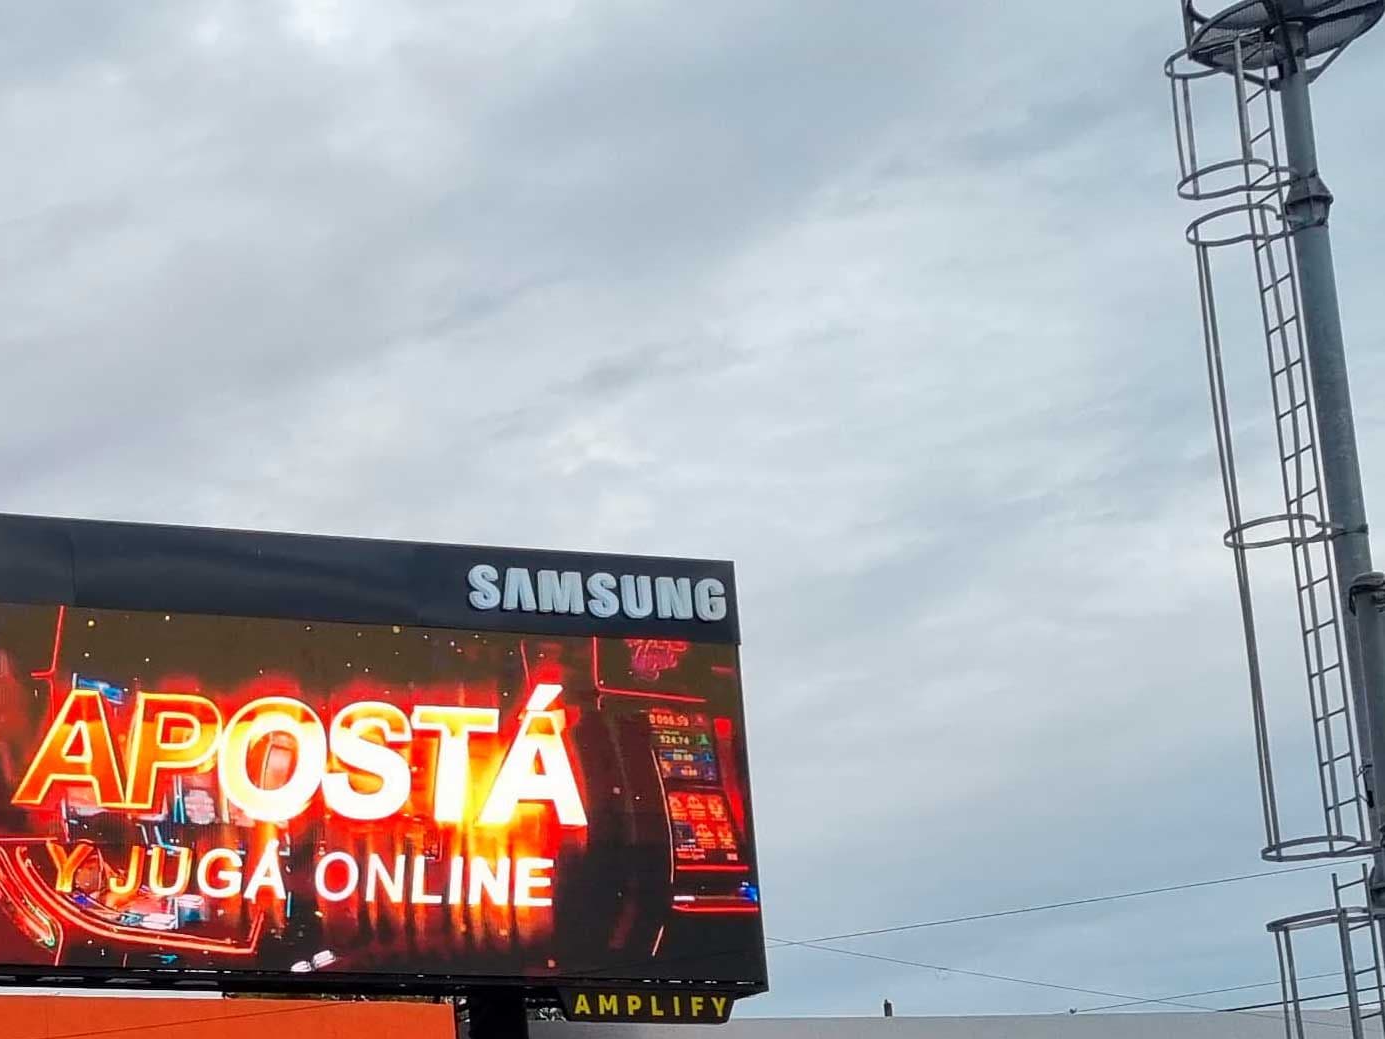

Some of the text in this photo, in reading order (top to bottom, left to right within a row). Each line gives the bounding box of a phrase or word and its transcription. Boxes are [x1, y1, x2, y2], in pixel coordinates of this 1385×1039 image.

[467, 563, 728, 622] SAMSUNG
[13, 683, 589, 827] APOSTÁ
[51, 842, 94, 893] Y
[314, 849, 555, 907] ONLINE
[574, 993, 729, 1019] AMPLIFY
